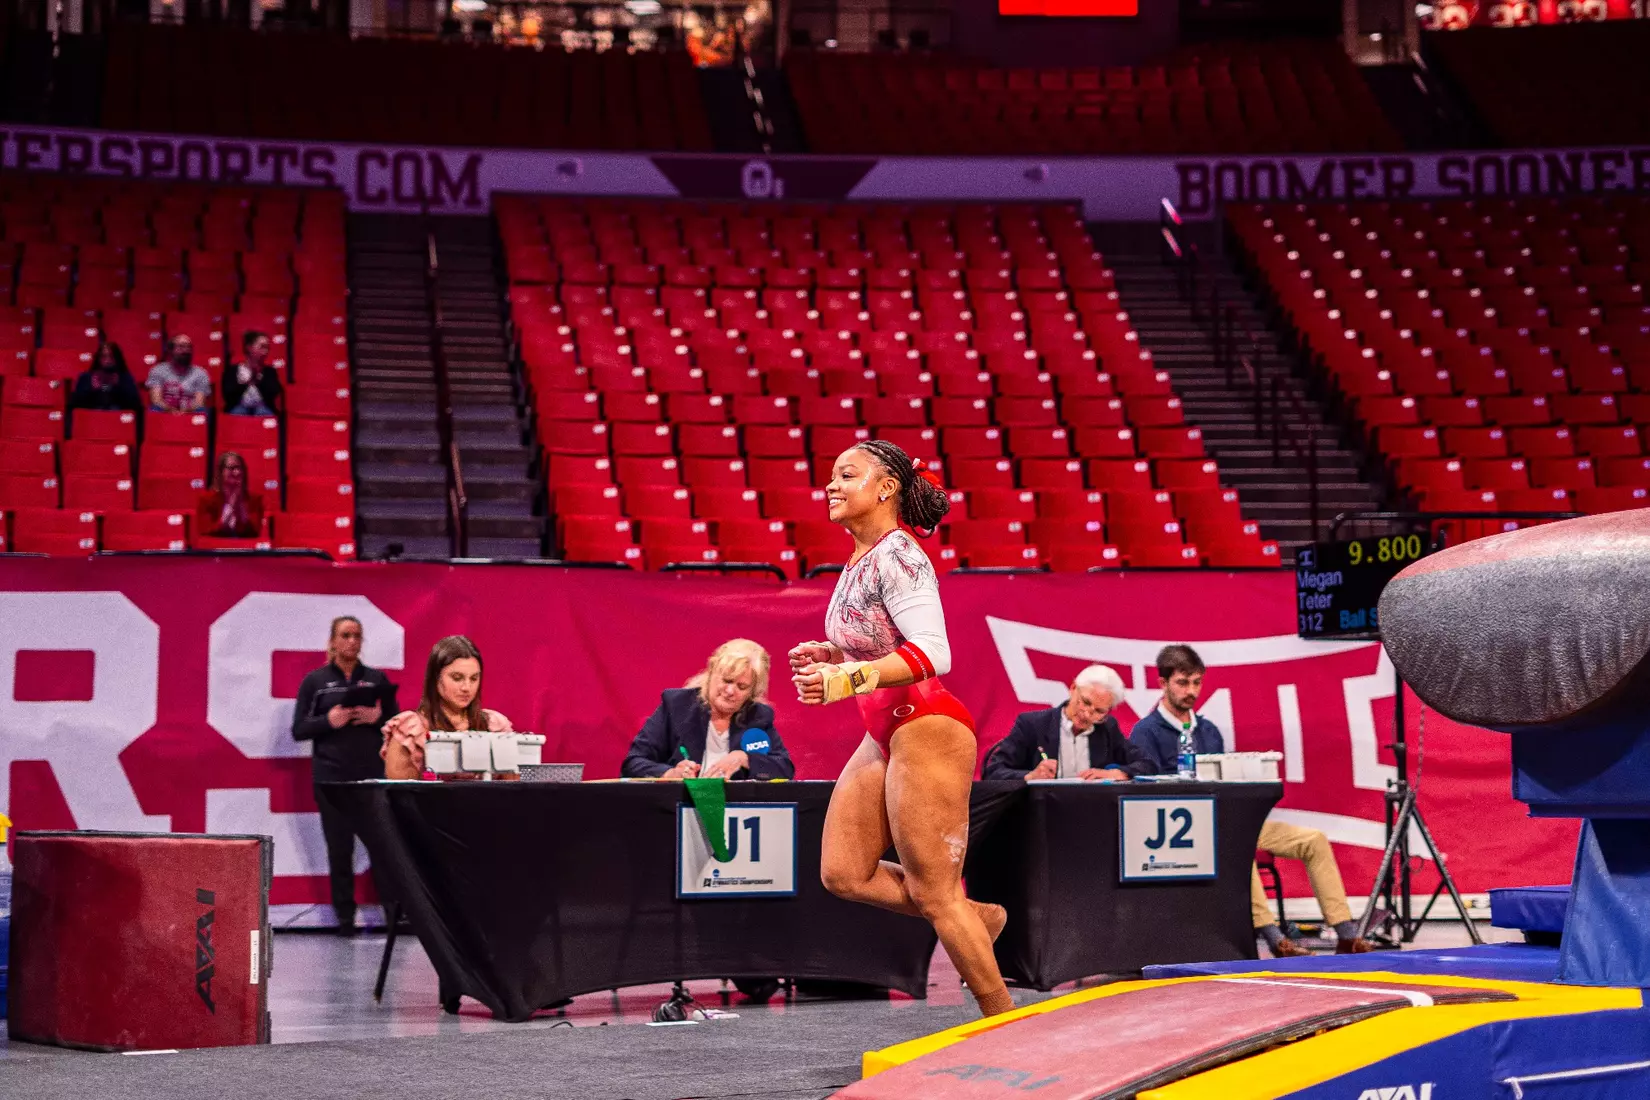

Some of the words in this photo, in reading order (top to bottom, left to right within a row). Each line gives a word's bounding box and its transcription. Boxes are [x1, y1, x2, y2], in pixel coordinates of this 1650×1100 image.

[0, 131, 338, 187] ERSPORTS
[1174, 156, 1416, 215] BOOMER
[1348, 534, 1422, 566] 9.800
[1296, 570, 1343, 591] Megan
[1297, 592, 1334, 611] Teter
[1339, 609, 1367, 629] Ball
[1143, 807, 1194, 850] J2
